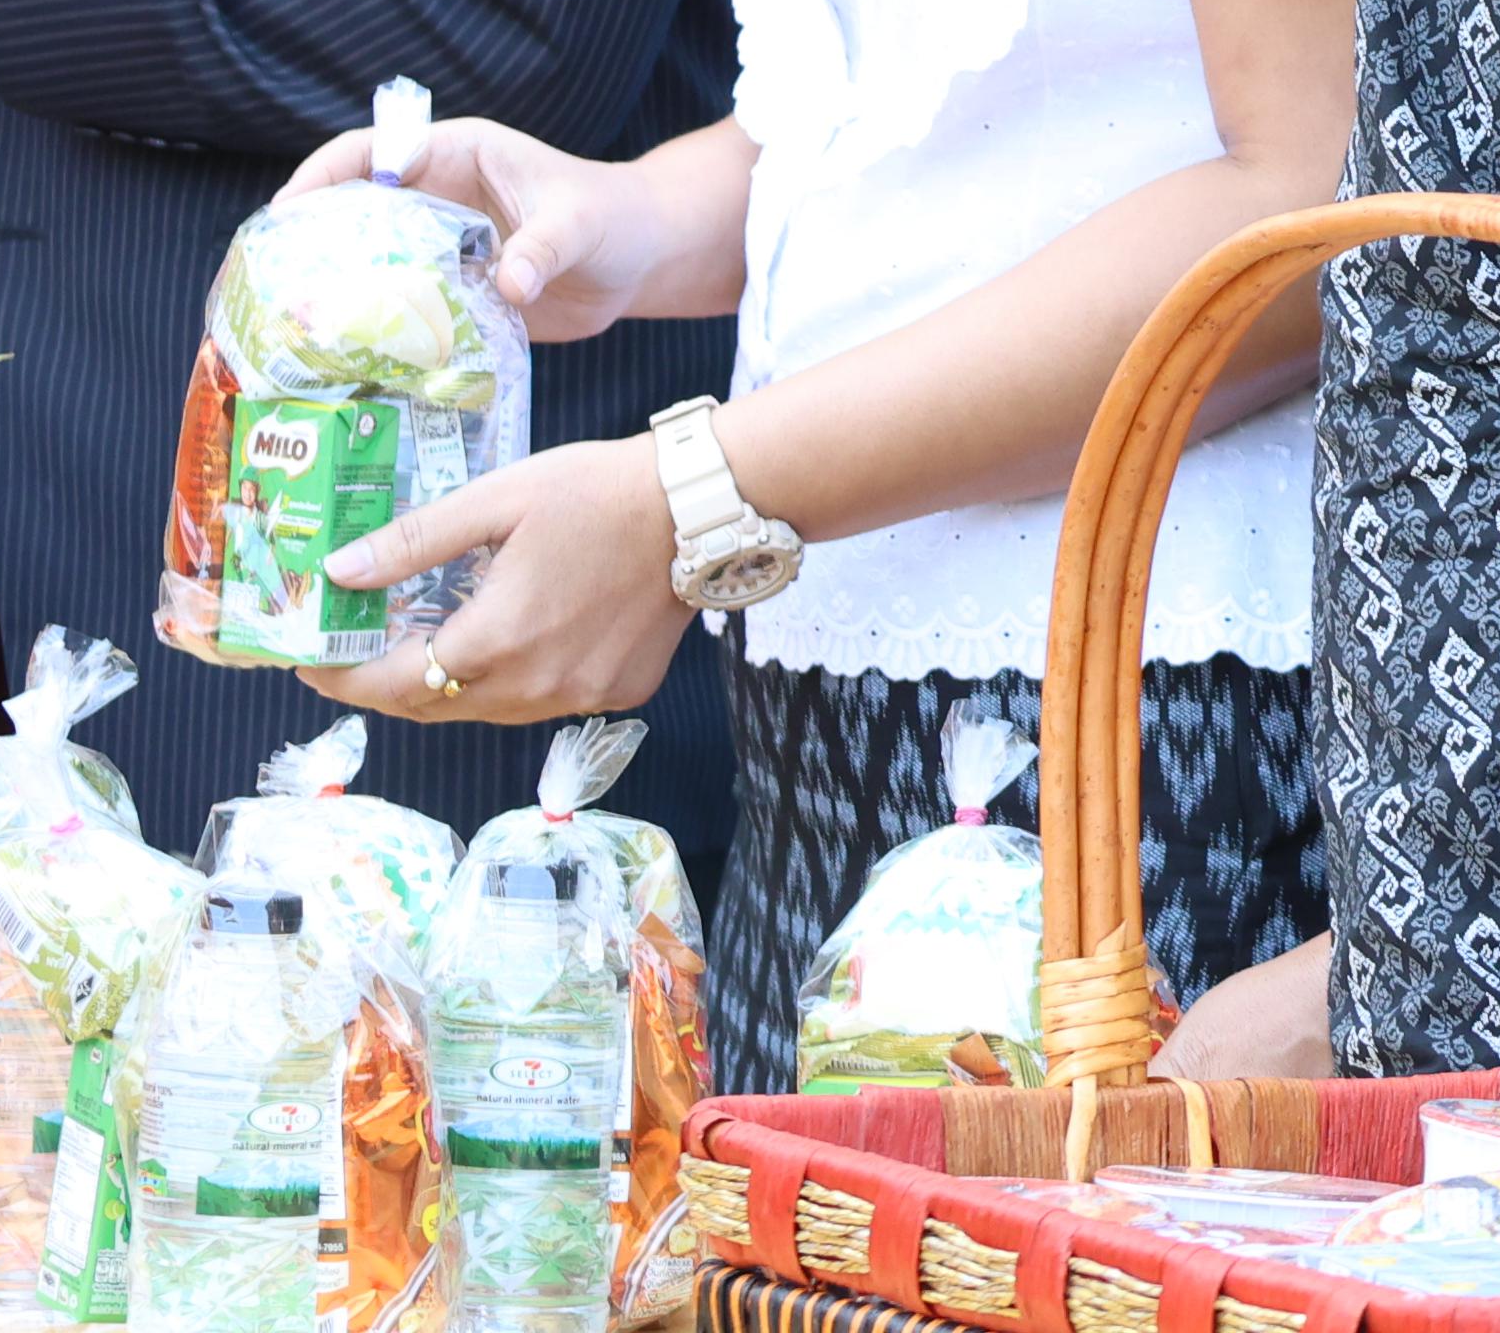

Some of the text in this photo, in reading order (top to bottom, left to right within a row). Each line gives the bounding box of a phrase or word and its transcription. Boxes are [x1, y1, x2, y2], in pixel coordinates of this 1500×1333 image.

[253, 431, 308, 461] MILO
[510, 1069, 553, 1079] SELECT
[477, 1094, 581, 1105] natural mineral water
[268, 1115, 307, 1125] SELECT
[232, 1140, 270, 1151] natural
[273, 1140, 307, 1151] mineral
